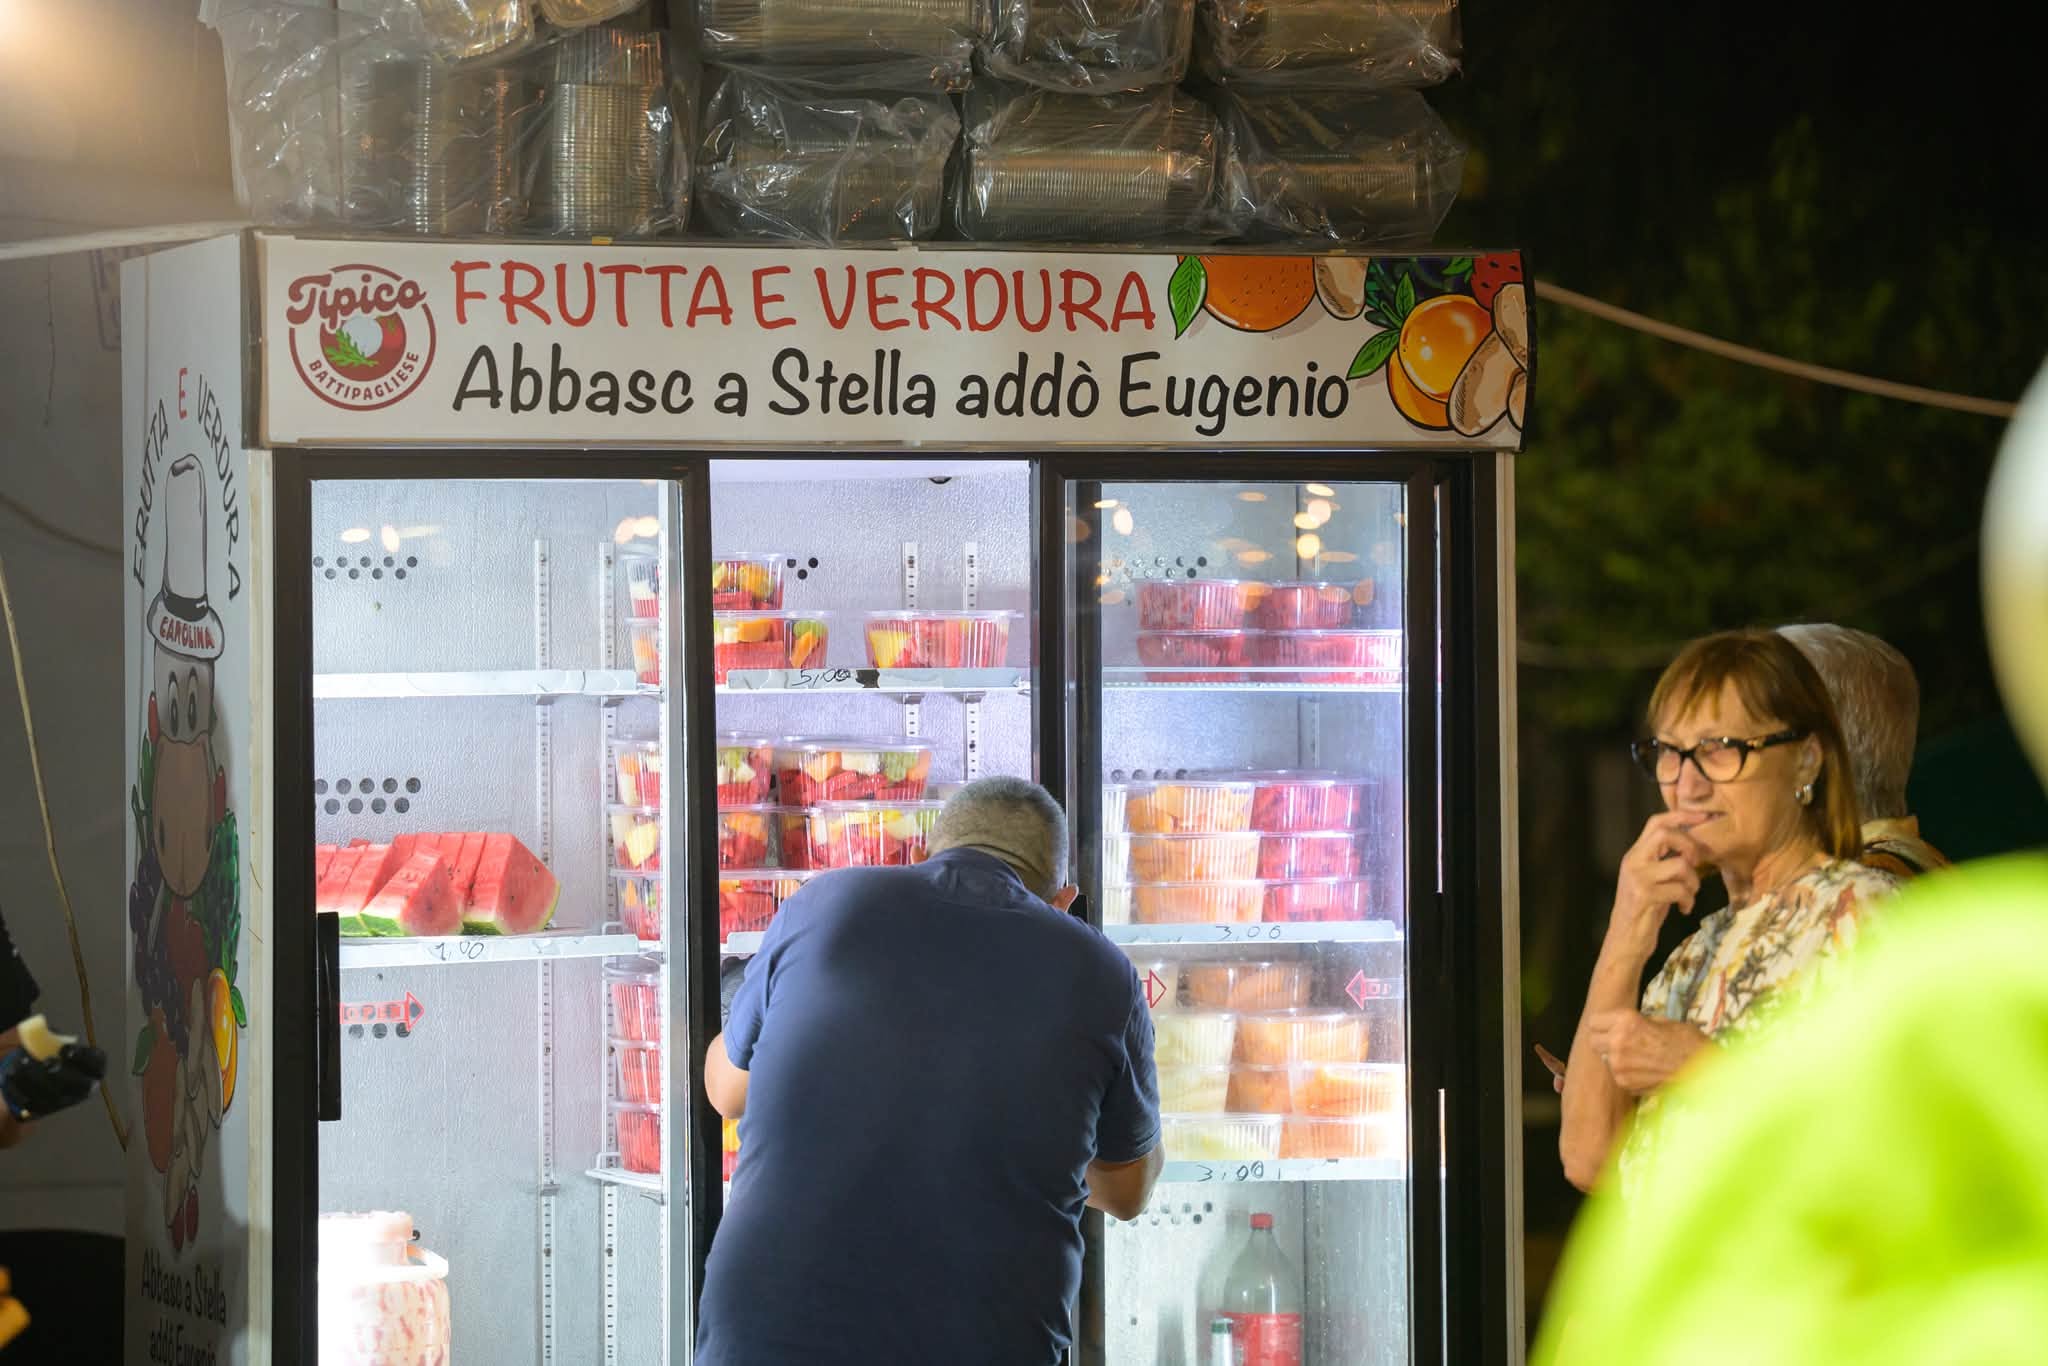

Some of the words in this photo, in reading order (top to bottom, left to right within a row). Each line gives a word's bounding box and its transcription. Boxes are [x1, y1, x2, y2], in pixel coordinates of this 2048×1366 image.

[286, 273, 427, 329] Tipico
[450, 260, 733, 328] FRUTTA
[753, 265, 797, 331] E
[814, 264, 1156, 333] VERDURA
[309, 351, 419, 401] BATTIPAGLIESE
[452, 342, 694, 415] Abbasc
[714, 371, 748, 417] a
[768, 347, 936, 417] Stella
[956, 351, 1099, 418] addò
[1119, 351, 1349, 437] Eugenio
[133, 398, 169, 590] FRUTTA
[178, 366, 188, 419] E
[198, 373, 241, 602] VERDURA
[159, 615, 215, 649] CAROLINA
[195, 1263, 226, 1328] Stella
